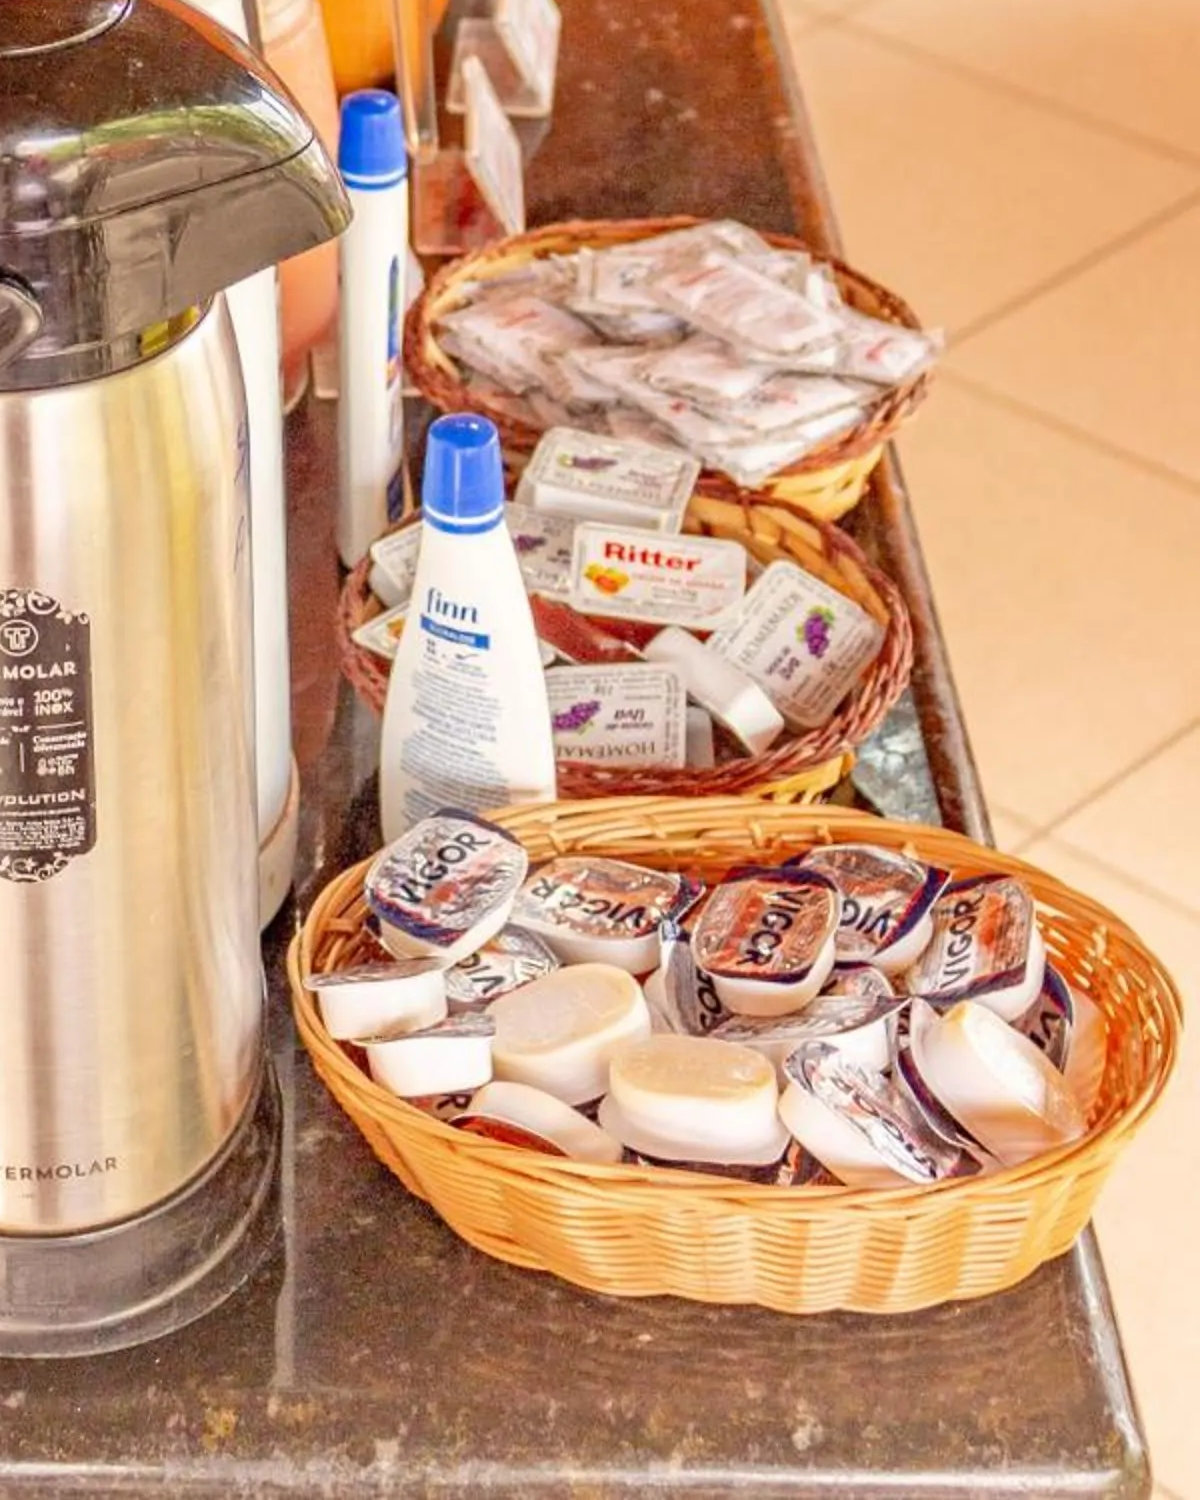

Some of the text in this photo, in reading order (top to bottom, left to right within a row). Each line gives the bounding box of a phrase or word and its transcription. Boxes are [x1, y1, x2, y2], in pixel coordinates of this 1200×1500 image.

[603, 541, 701, 573] Ritter
[426, 587, 477, 623] finn
[33, 687, 74, 703] 100%
[34, 702, 73, 716] INOX
[390, 830, 493, 904] VIGOR
[736, 888, 811, 966] VIGOR
[940, 893, 985, 990] VIGOR
